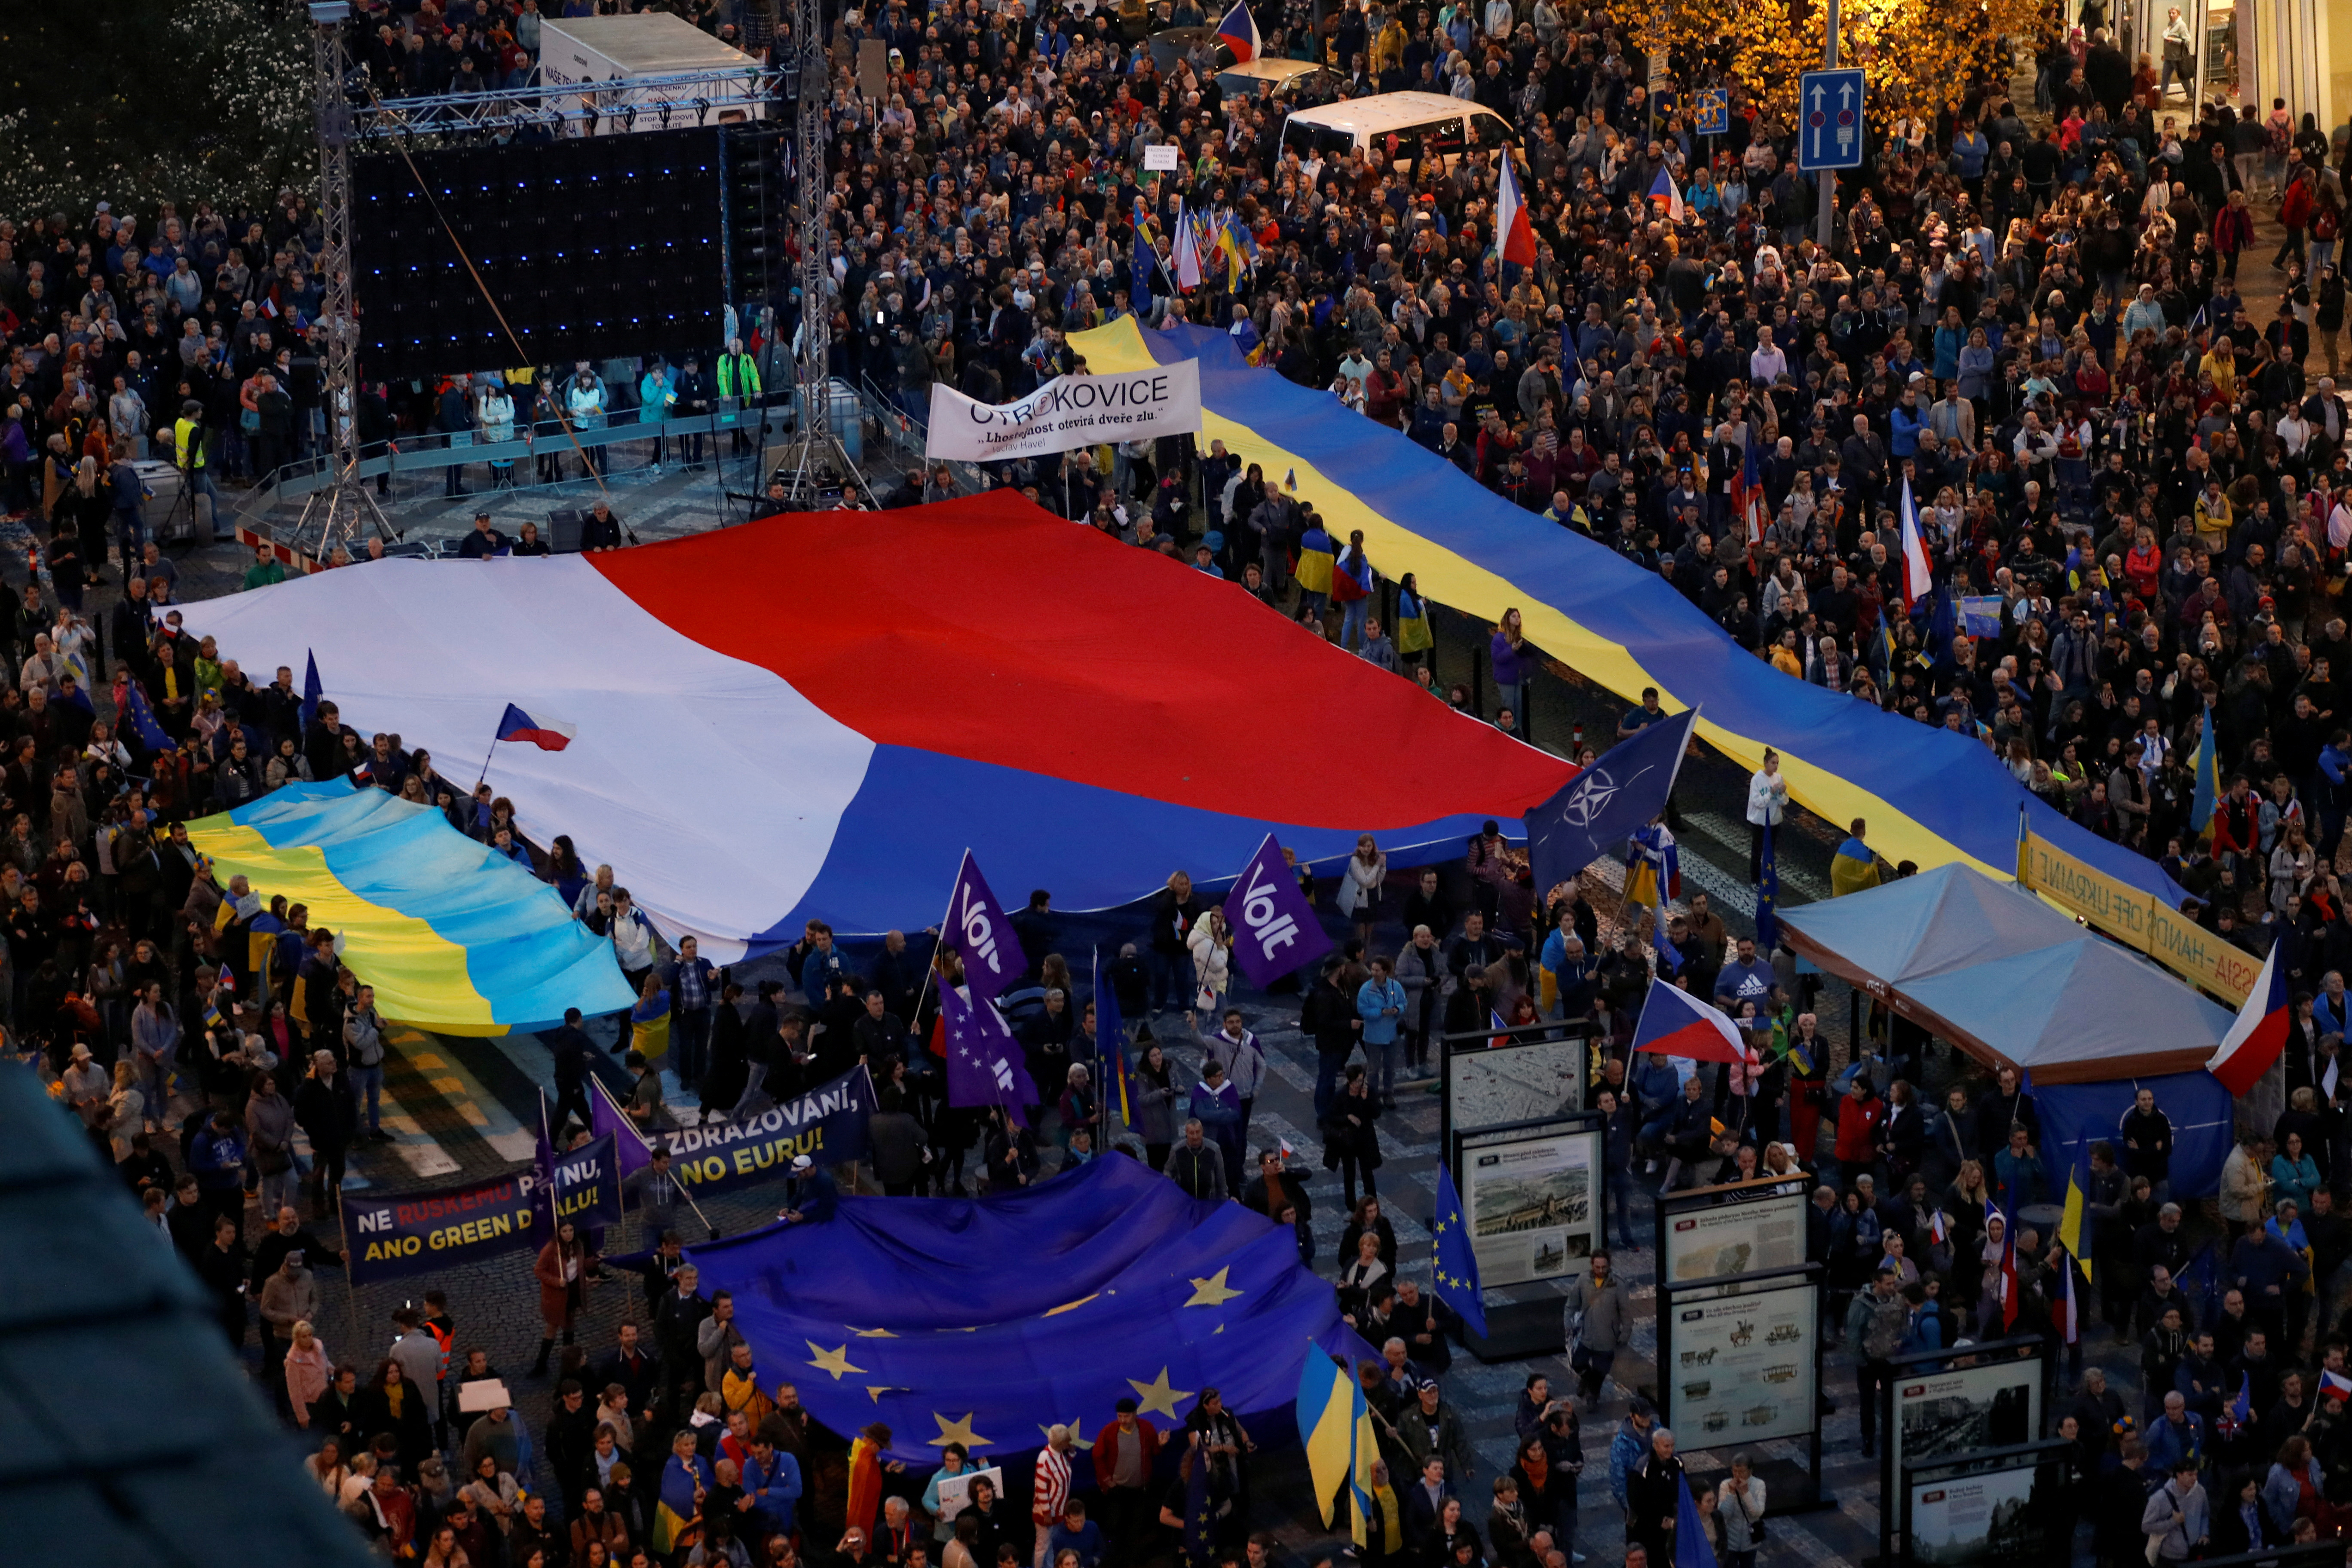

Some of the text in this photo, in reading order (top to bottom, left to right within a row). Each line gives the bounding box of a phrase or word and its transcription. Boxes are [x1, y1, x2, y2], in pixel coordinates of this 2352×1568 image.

[659, 113, 694, 122] CVIDOVÉ
[1058, 414, 1094, 430] otevírá
[1099, 409, 1132, 425] dveře
[1021, 438, 1045, 449] Havel
[1243, 861, 1299, 962] Volt
[1736, 986, 1767, 996] adidas
[680, 1127, 824, 1185] NO EURU!
[357, 1209, 393, 1233] NE
[364, 1185, 599, 1262] ANO GREEN DALU!
